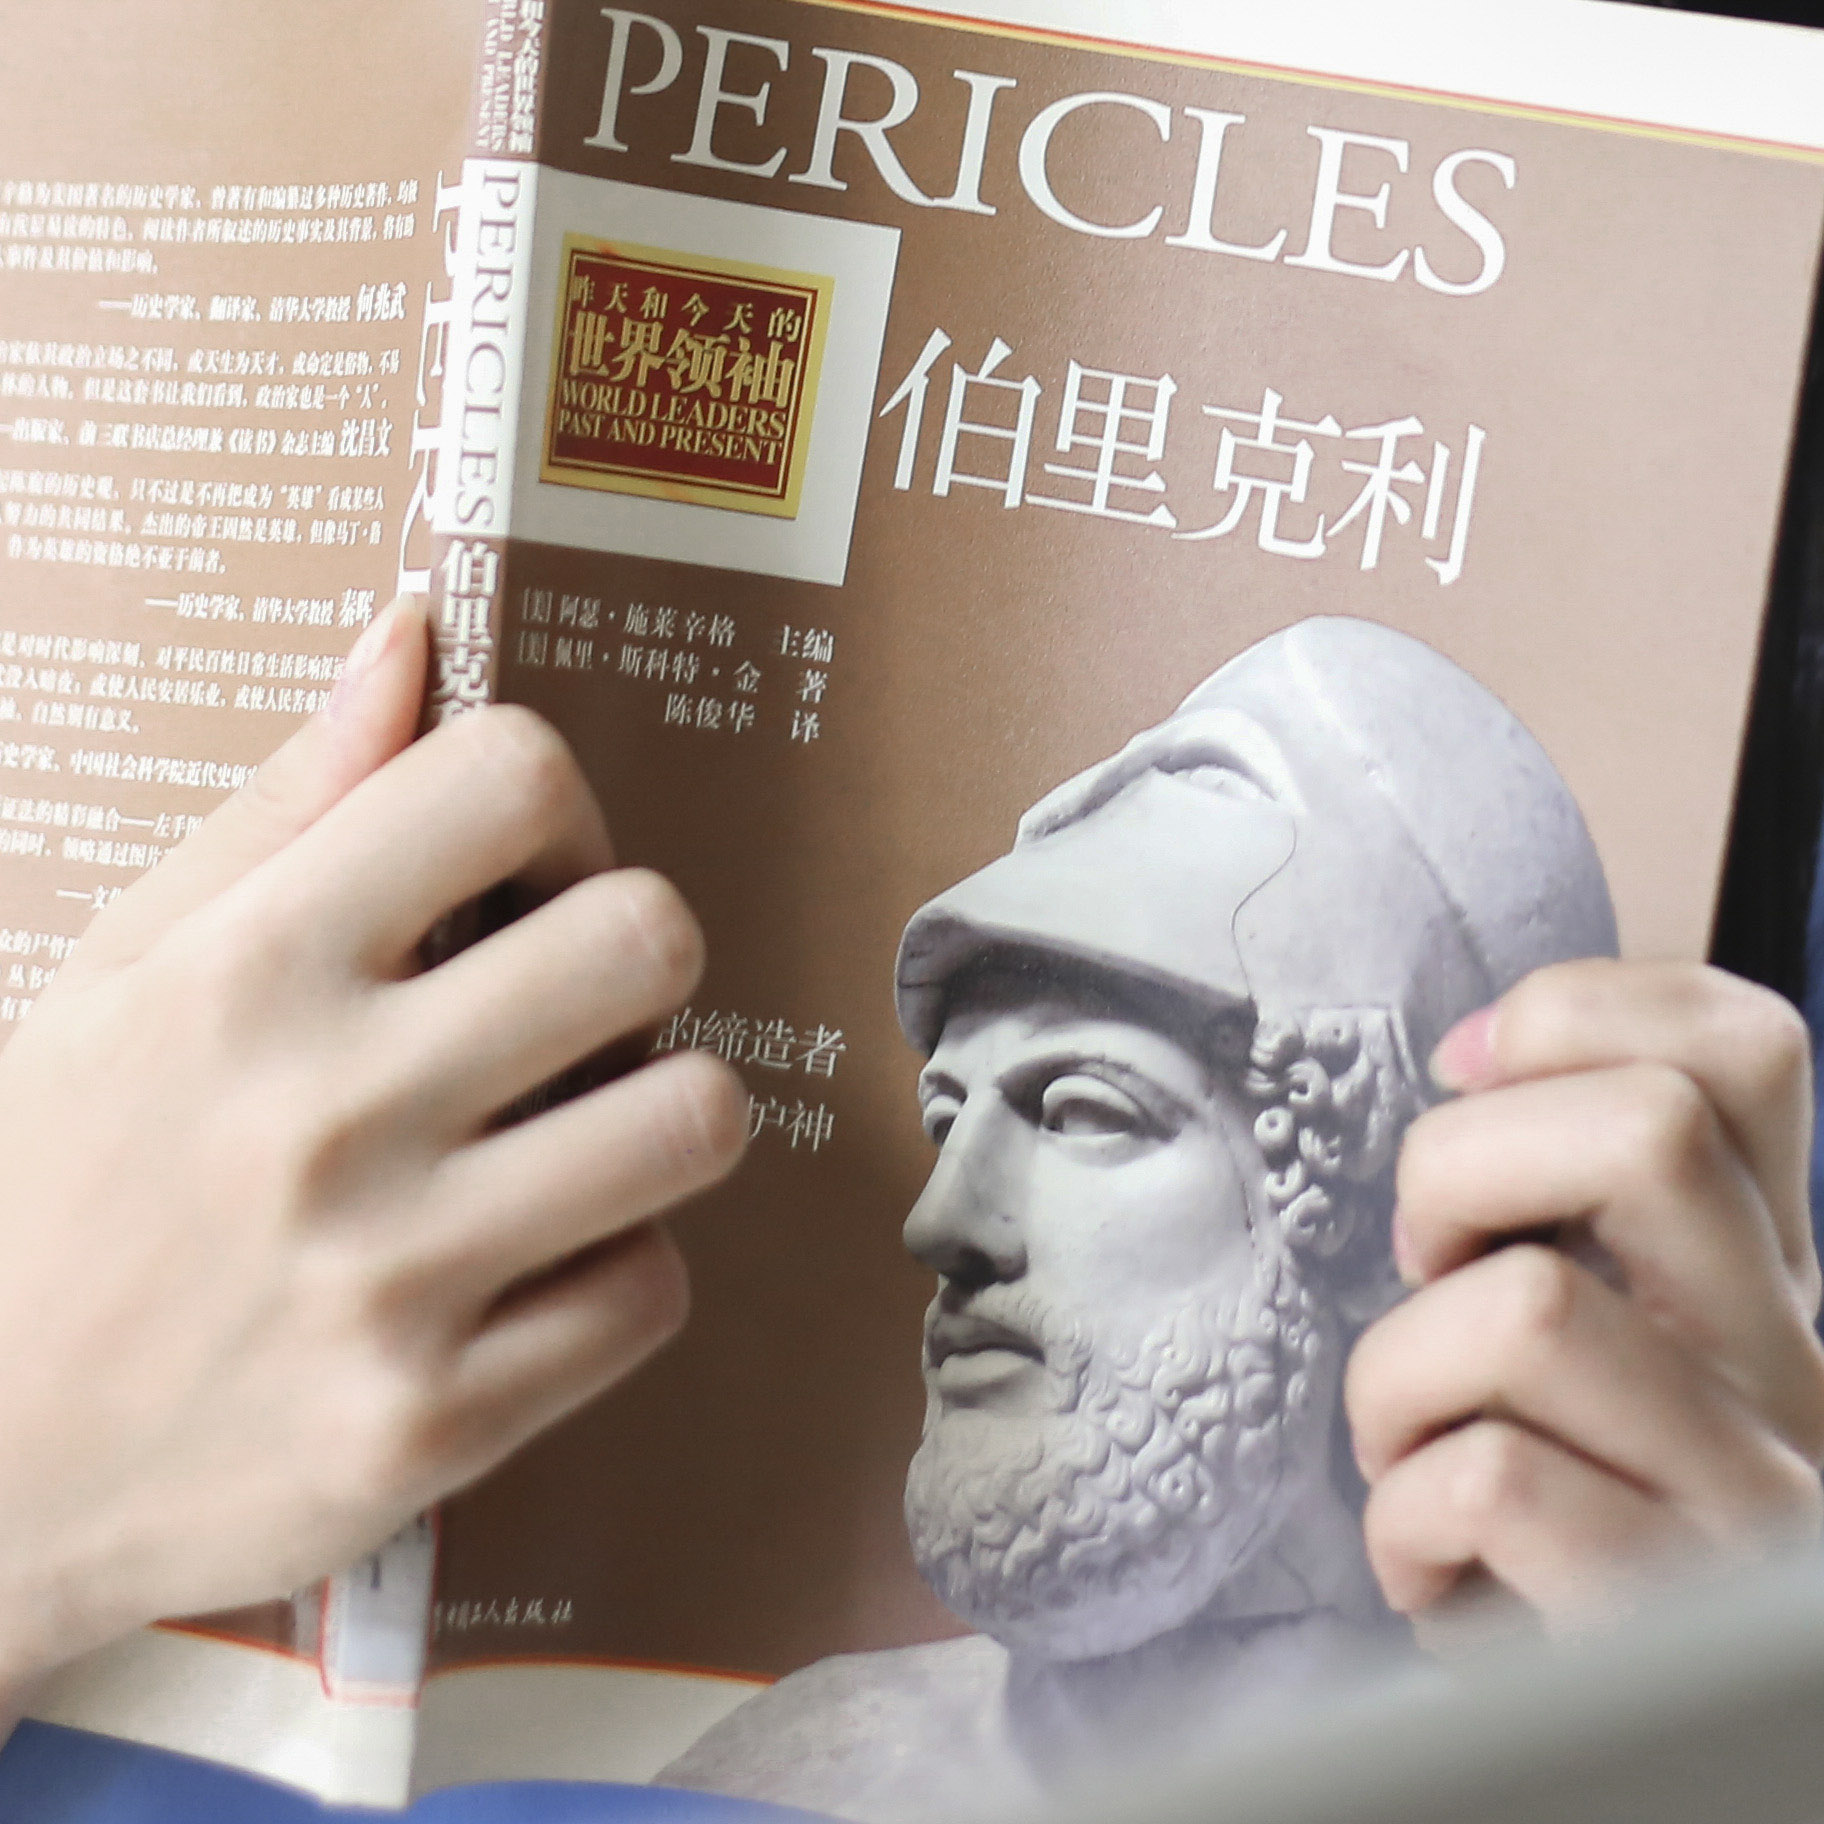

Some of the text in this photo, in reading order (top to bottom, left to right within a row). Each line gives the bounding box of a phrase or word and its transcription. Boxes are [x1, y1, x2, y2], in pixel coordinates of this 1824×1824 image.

[582, 6, 1519, 295] PERICLES
[570, 275, 802, 342] 昨天和今天的
[453, 169, 522, 528] PERICLES
[569, 311, 796, 409] 世界领袖
[559, 410, 784, 466] PAST AND PRESENT
[562, 381, 785, 440] WORLD LEADERS
[881, 328, 1490, 587] 伯里克利
[432, 541, 499, 718] 伯里克
[780, 624, 834, 663] 主编
[664, 693, 822, 744] 陈俊华 译
[797, 670, 829, 704] 著
